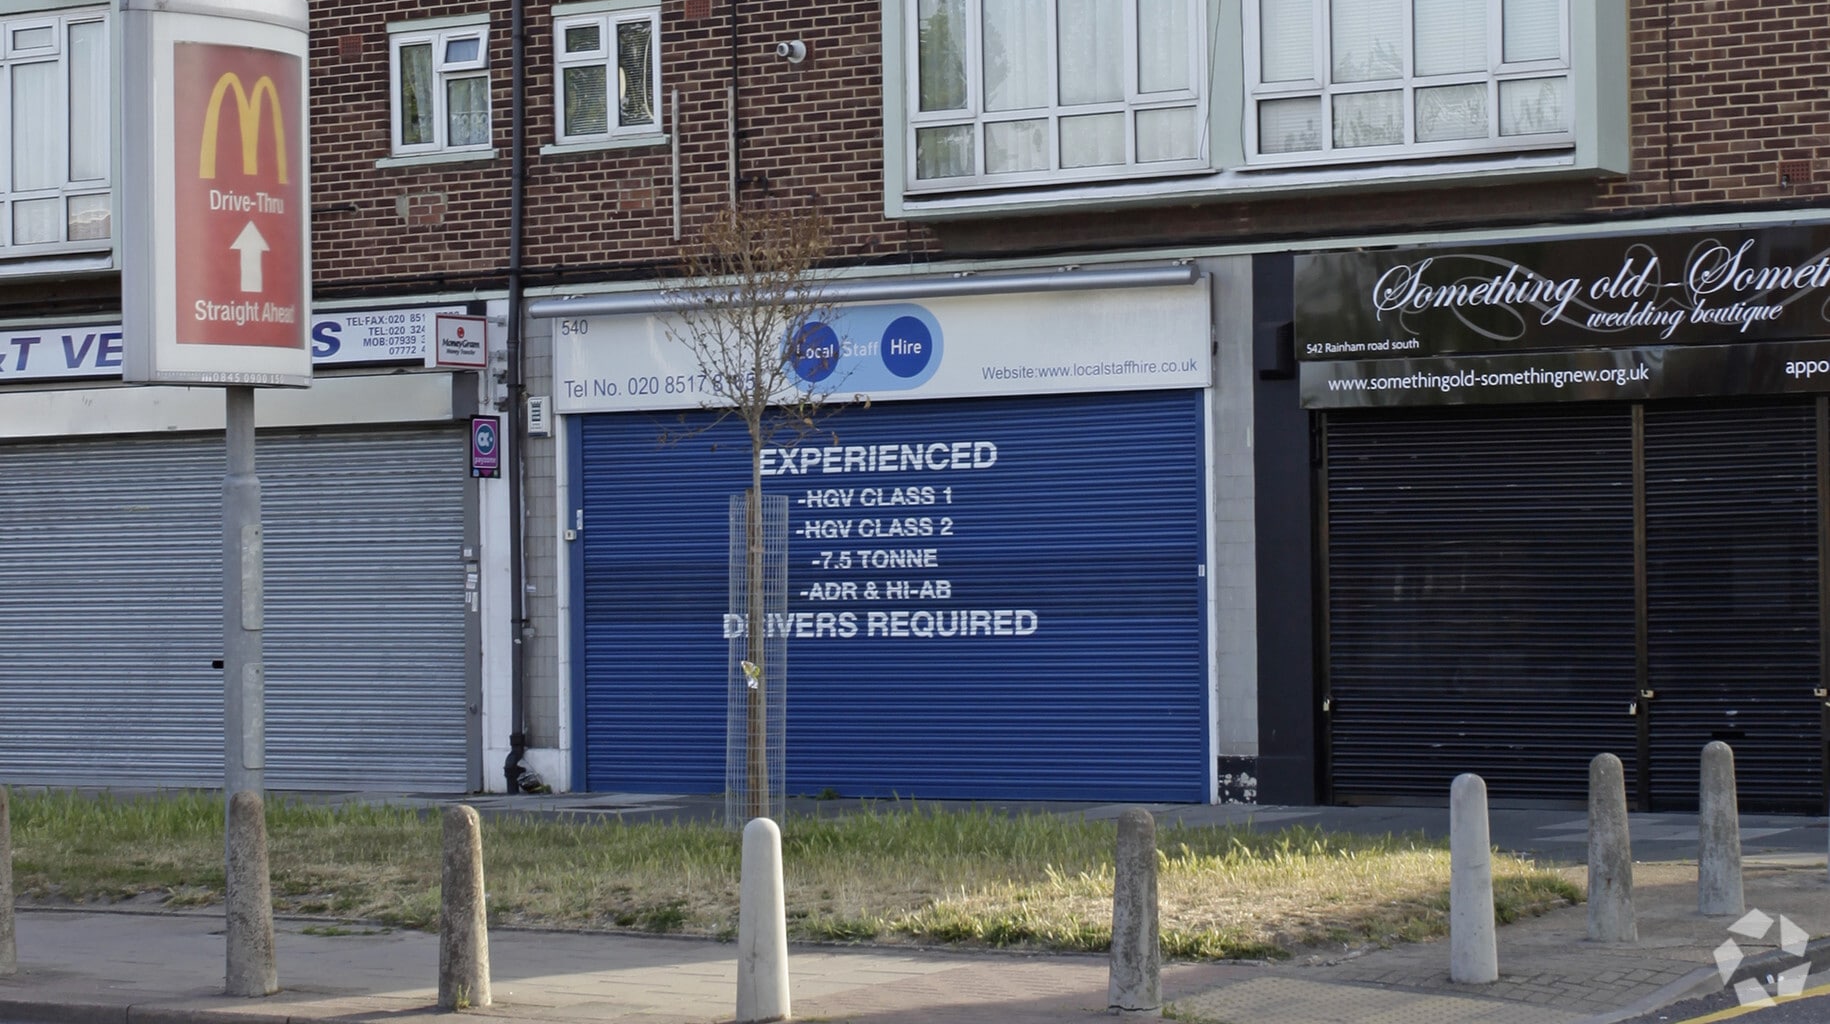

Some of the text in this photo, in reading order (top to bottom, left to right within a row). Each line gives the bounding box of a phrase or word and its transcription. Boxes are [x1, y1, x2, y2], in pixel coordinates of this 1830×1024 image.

[209, 190, 285, 215] Drive-Thru
[1373, 257, 1581, 326] Something
[1589, 257, 1659, 300] old
[194, 299, 296, 326] Straight Ahead
[1587, 298, 1784, 340] wedding boutique
[561, 319, 589, 336] 540
[61, 332, 123, 369] VE
[311, 321, 343, 358] S
[442, 338, 480, 349] MoneyGram
[842, 340, 879, 358] Staff
[890, 338, 922, 355] Hire
[1306, 338, 1420, 354] 542 Rainham road south
[564, 379, 588, 398] Tel
[593, 379, 622, 397] No.
[628, 376, 659, 396] 020
[664, 373, 706, 394] 8517
[1328, 363, 1649, 392] www.somethingold-somethingnew.org.uk
[759, 441, 998, 475] EXPERIENCED
[859, 486, 935, 506] CLASS
[943, 486, 953, 505] 1
[857, 518, 934, 537] CLASS
[940, 517, 954, 536] 2
[857, 548, 939, 568] TONNE
[863, 581, 880, 599] &
[886, 579, 952, 599] HI-AB
[723, 609, 1038, 639] DIVERS REQUIRED
